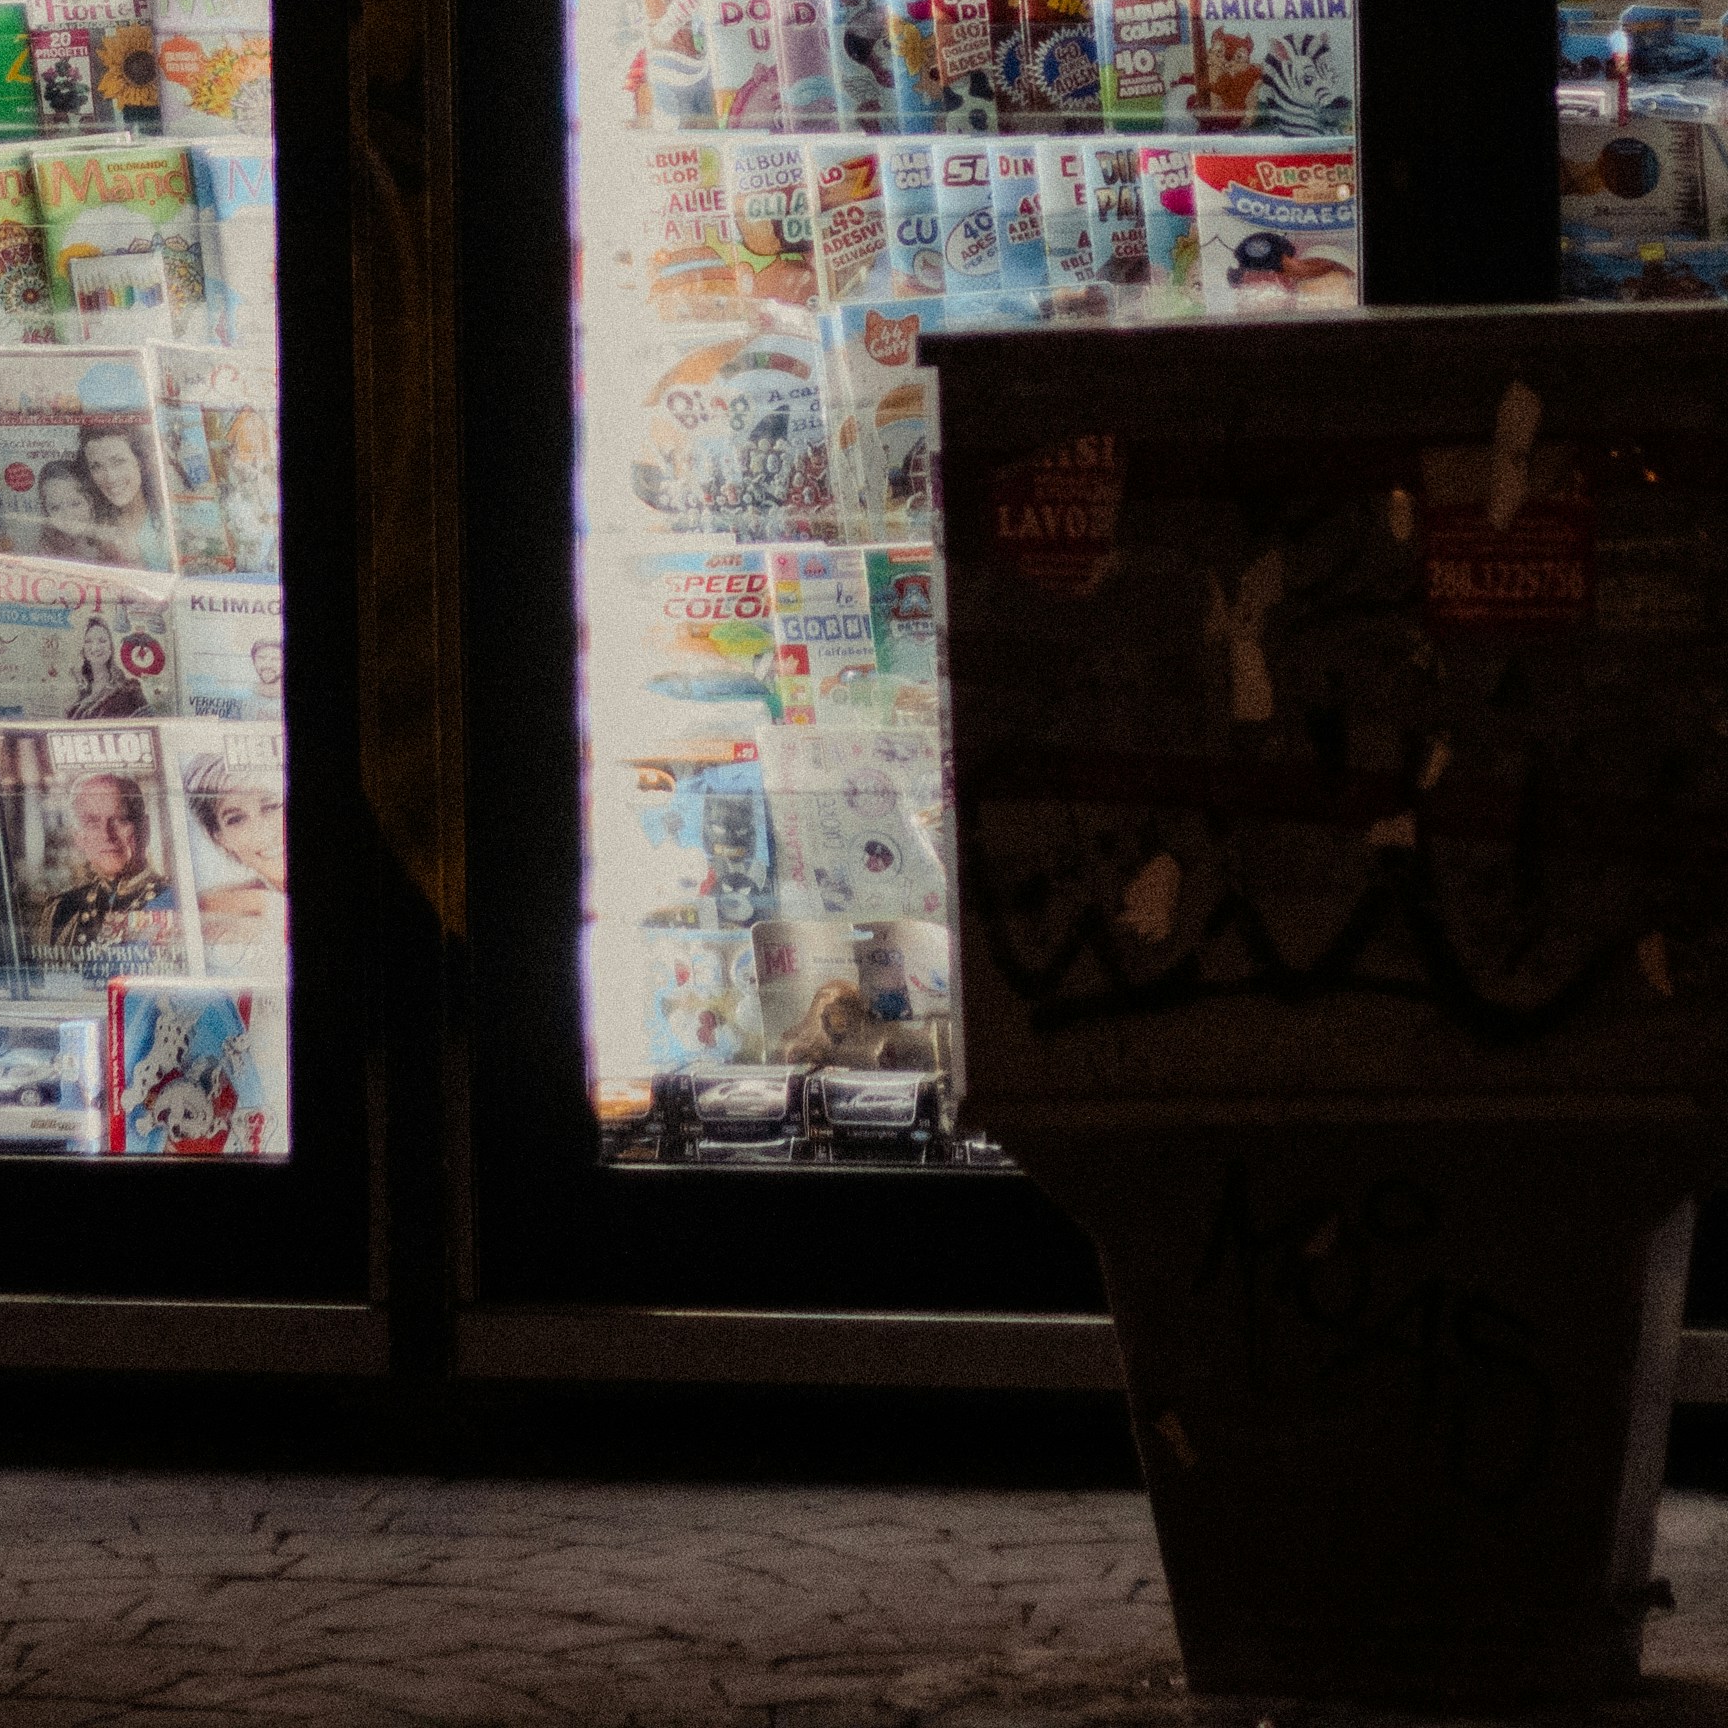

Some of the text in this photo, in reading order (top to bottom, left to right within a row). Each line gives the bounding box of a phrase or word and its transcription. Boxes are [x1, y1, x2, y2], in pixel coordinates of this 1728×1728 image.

[1205, 0, 1274, 21] AMICI
[50, 32, 72, 46] 20
[665, 573, 768, 595] SPEED
